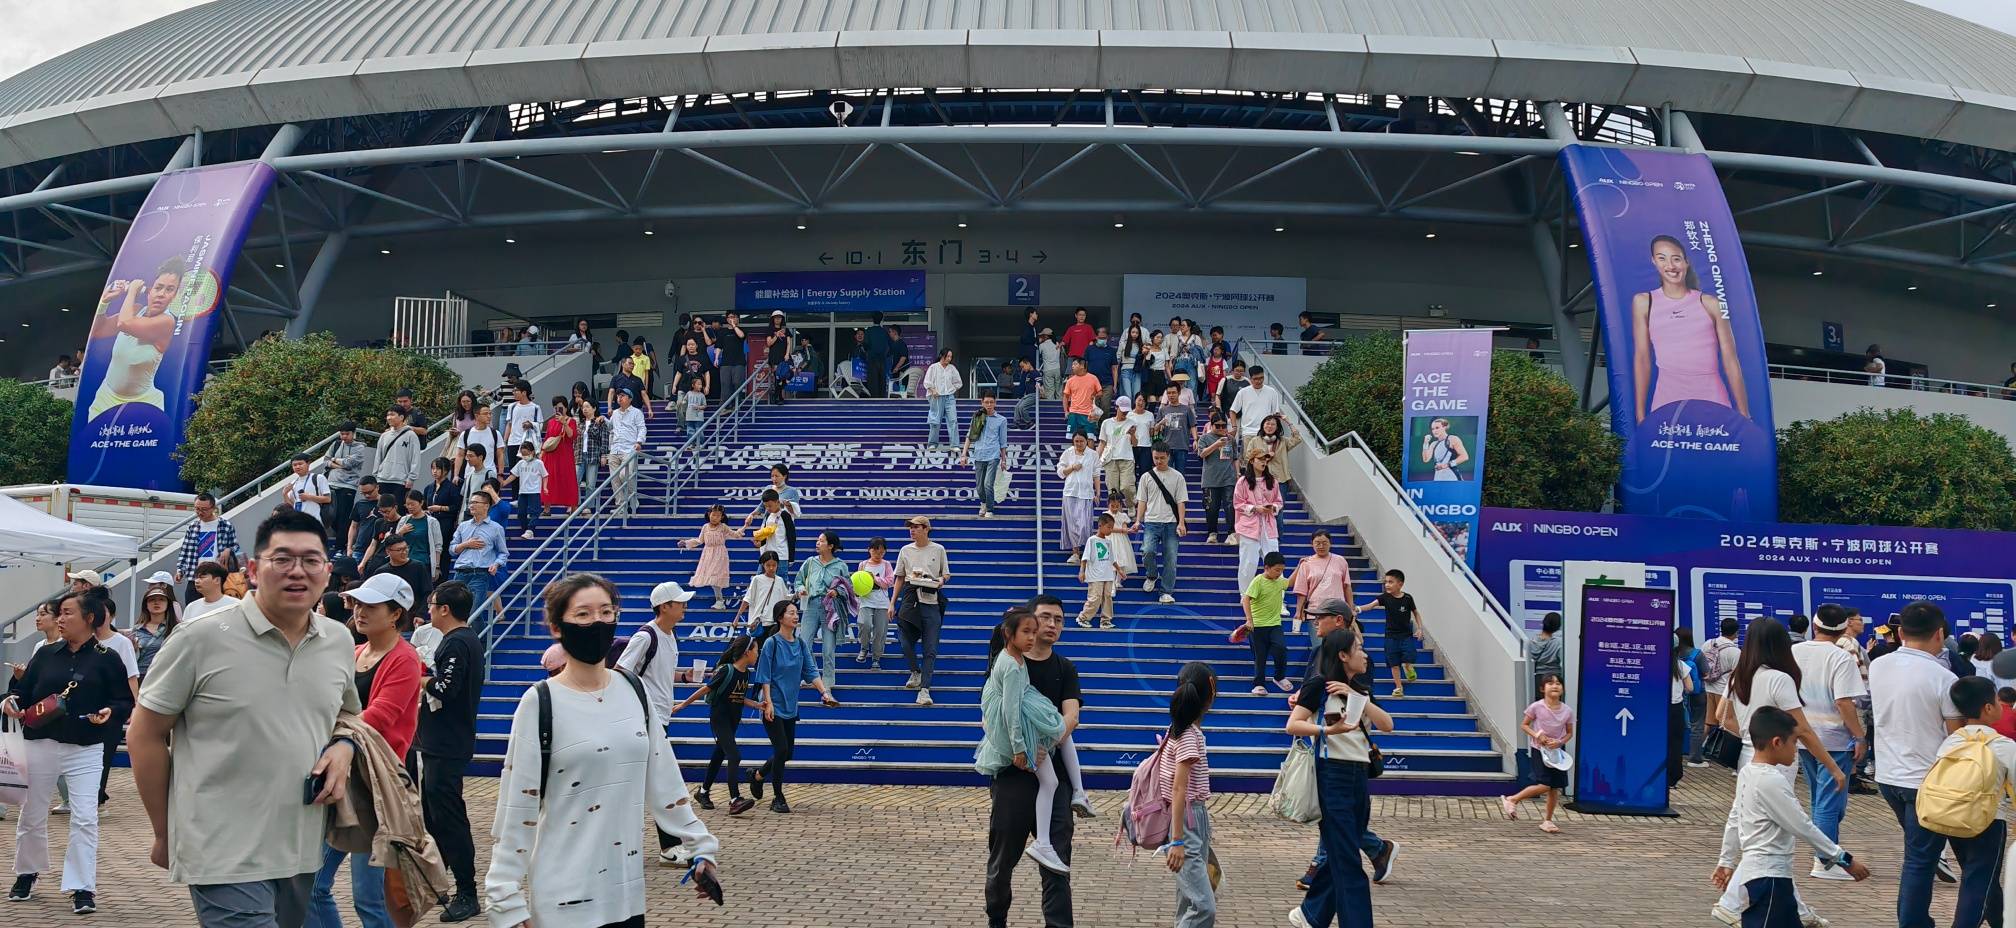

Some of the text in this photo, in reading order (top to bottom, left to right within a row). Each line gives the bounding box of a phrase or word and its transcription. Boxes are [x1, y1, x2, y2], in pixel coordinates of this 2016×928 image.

[1684, 220, 1701, 251] 郑钦文
[902, 239, 963, 266] 东门
[1699, 220, 1731, 320] ZHENG QINWEN
[755, 289, 799, 299] 能量补给站
[807, 287, 905, 299] Energy Supply Station
[173, 287, 193, 336] PAOLINI
[1413, 372, 1453, 384] ACE
[1412, 385, 1449, 398] THE
[1411, 399, 1468, 411] GAME
[132, 439, 158, 447] GAME
[1704, 443, 1740, 452] GAME
[718, 486, 766, 501] 202
[855, 486, 949, 501] NINGBO
[1418, 504, 1477, 516] NGBO
[1491, 522, 1618, 537] AUX NINGBO OPEN
[1720, 534, 1939, 556] 2024奥克斯·宁波网球公开赛
[1758, 554, 1892, 566] 2024 AUX NINGBO OPEN
